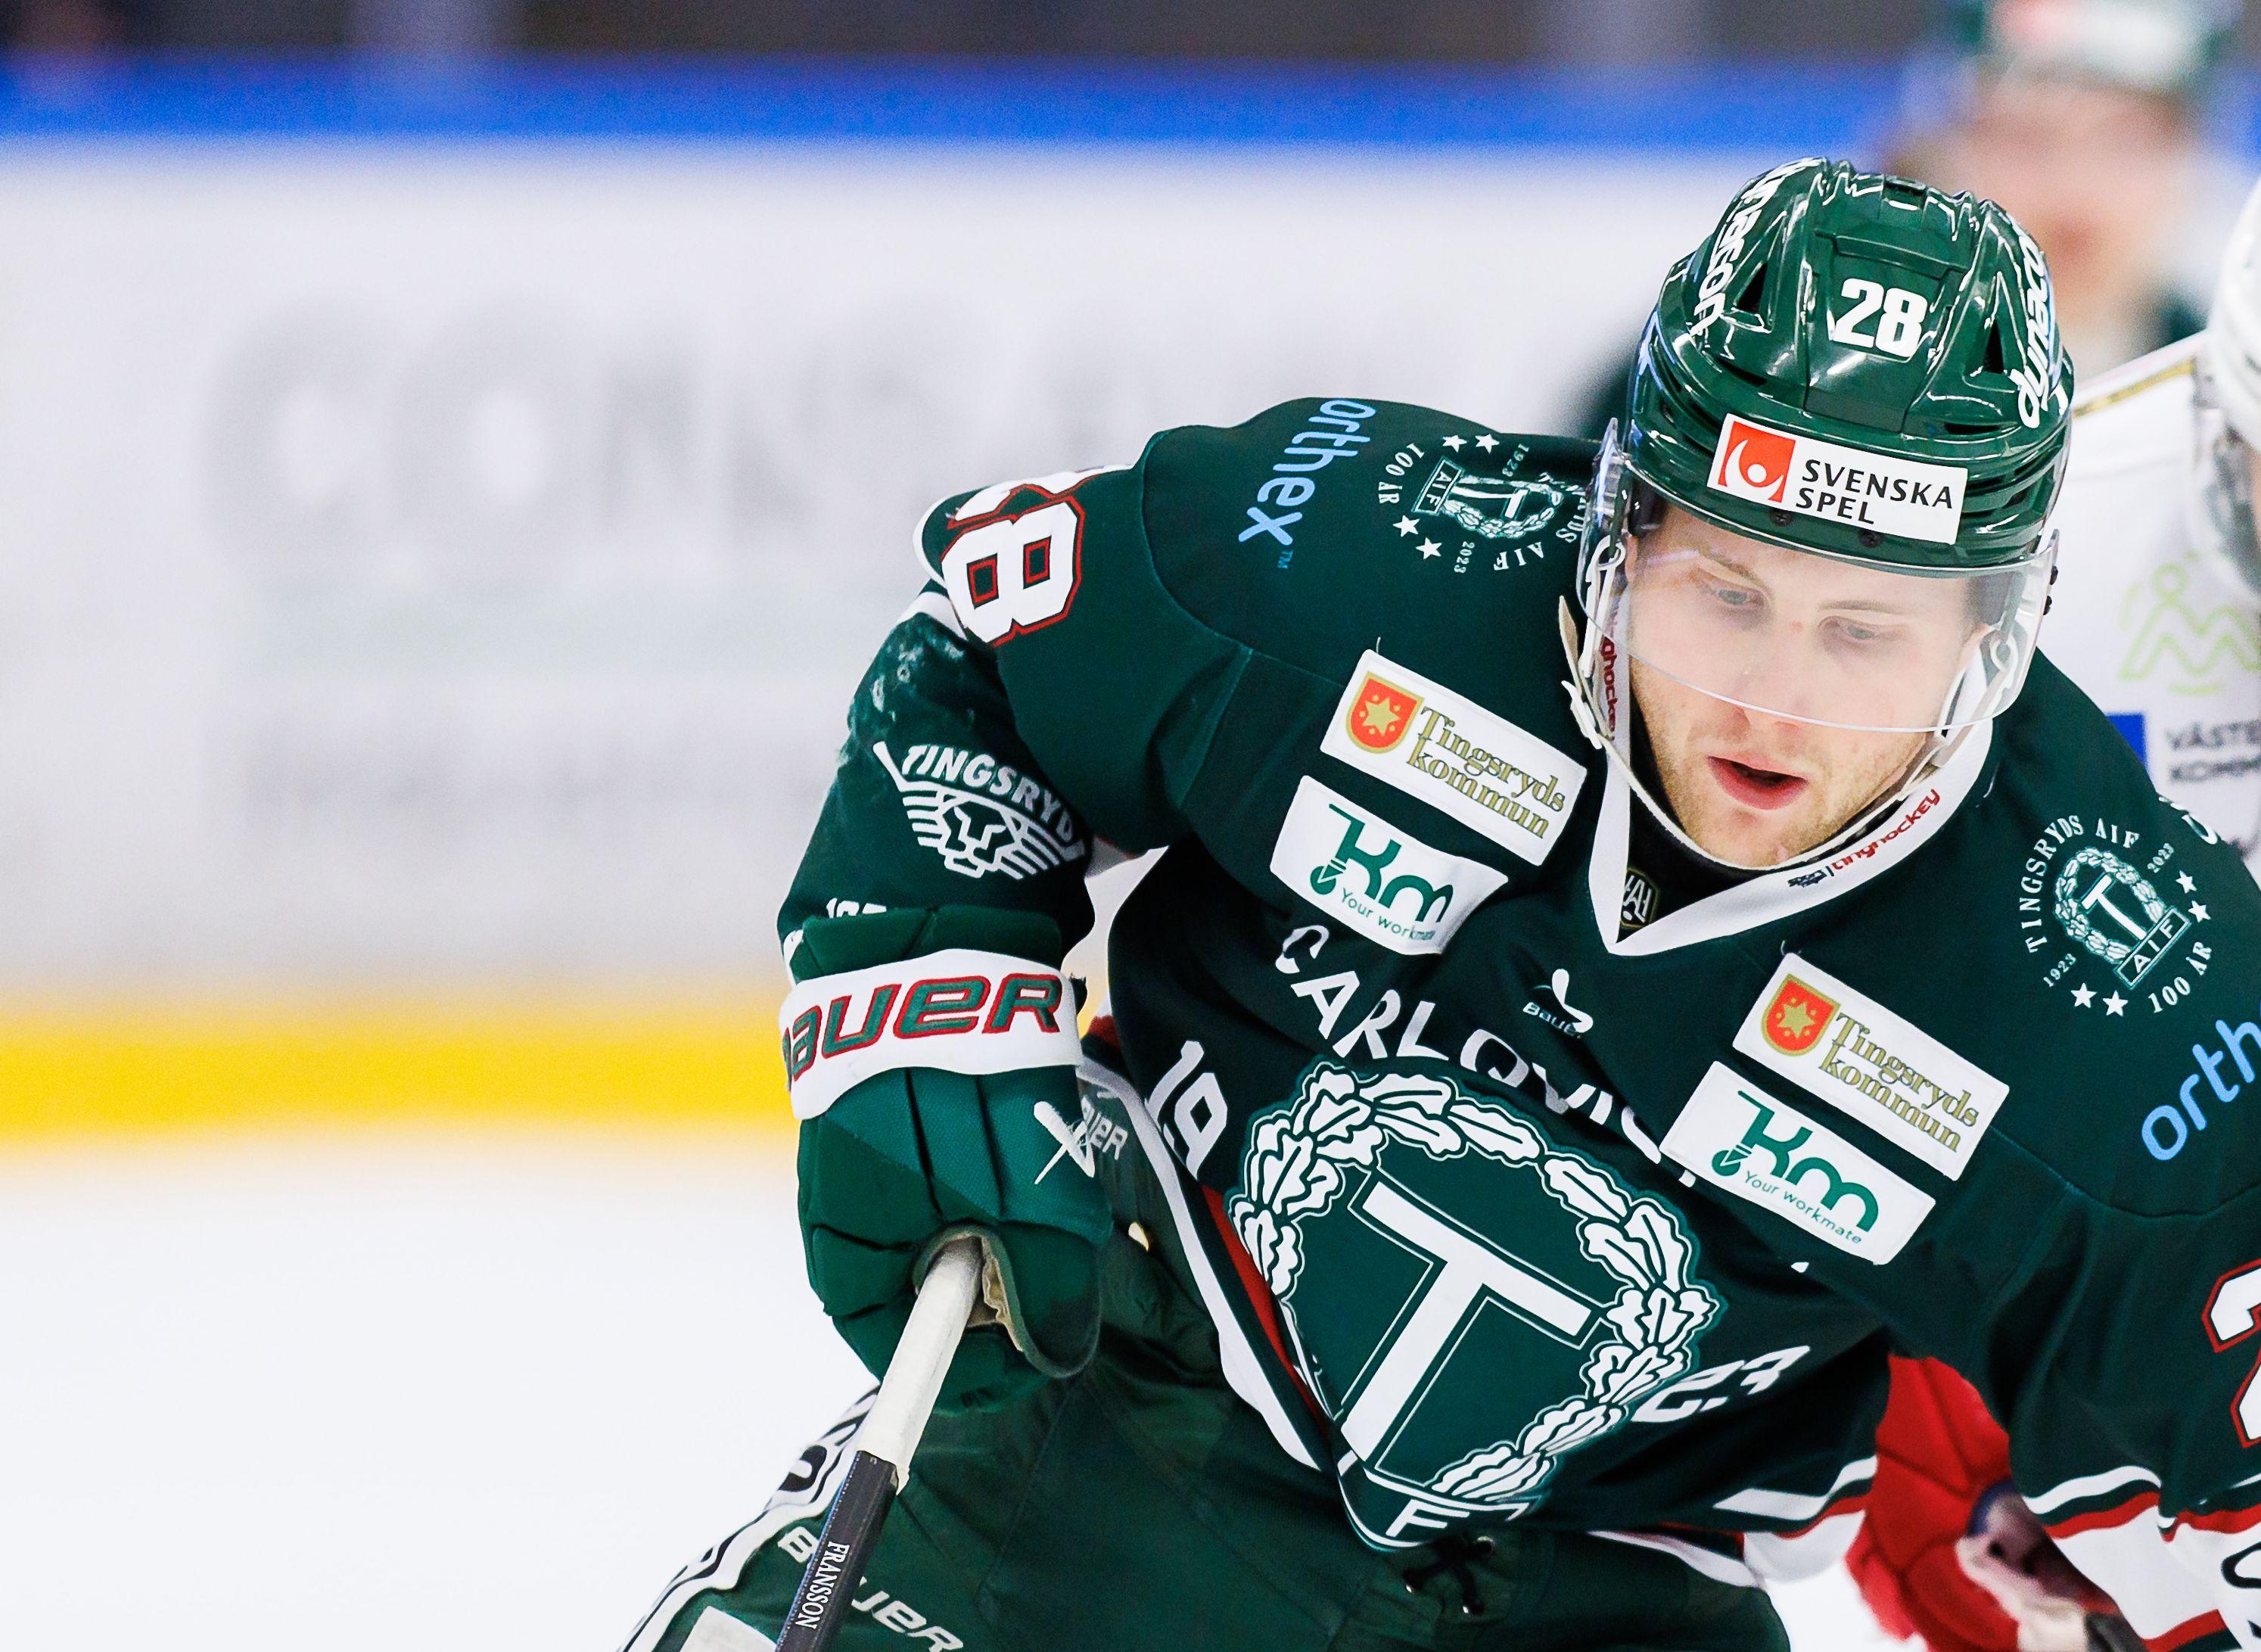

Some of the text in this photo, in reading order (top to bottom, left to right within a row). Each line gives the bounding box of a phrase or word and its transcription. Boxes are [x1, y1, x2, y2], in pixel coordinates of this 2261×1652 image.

[1828, 278, 1927, 362] 28
[2009, 229, 2052, 428] dynaco
[1238, 399, 1376, 546] orthex
[1386, 443, 1424, 476] 100
[1426, 470, 1453, 506] AIF
[1802, 459, 1953, 509] SVENSKA
[1795, 488, 1875, 524] SPEL
[1454, 541, 1475, 574] 2023
[1493, 541, 1544, 571] AIF
[1406, 735, 1550, 839] kommun
[1420, 705, 1566, 812] Tingsryds
[2019, 815, 2083, 954] TINGSRYDS
[2095, 818, 2139, 848] AIF
[2147, 842, 2174, 873] 2023
[1342, 888, 1373, 918] Your
[2043, 953, 2077, 988] 1923
[2133, 919, 2173, 974] AIF
[2147, 977, 2191, 1013] 100
[1818, 1042, 1962, 1153] kommun
[1835, 1012, 1980, 1128] Tingsryds
[1145, 1040, 1228, 1181] 19
[1745, 1170, 1862, 1244] Your workmate
[1341, 1181, 1592, 1463] T
[795, 1540, 851, 1630] FRANSSON
